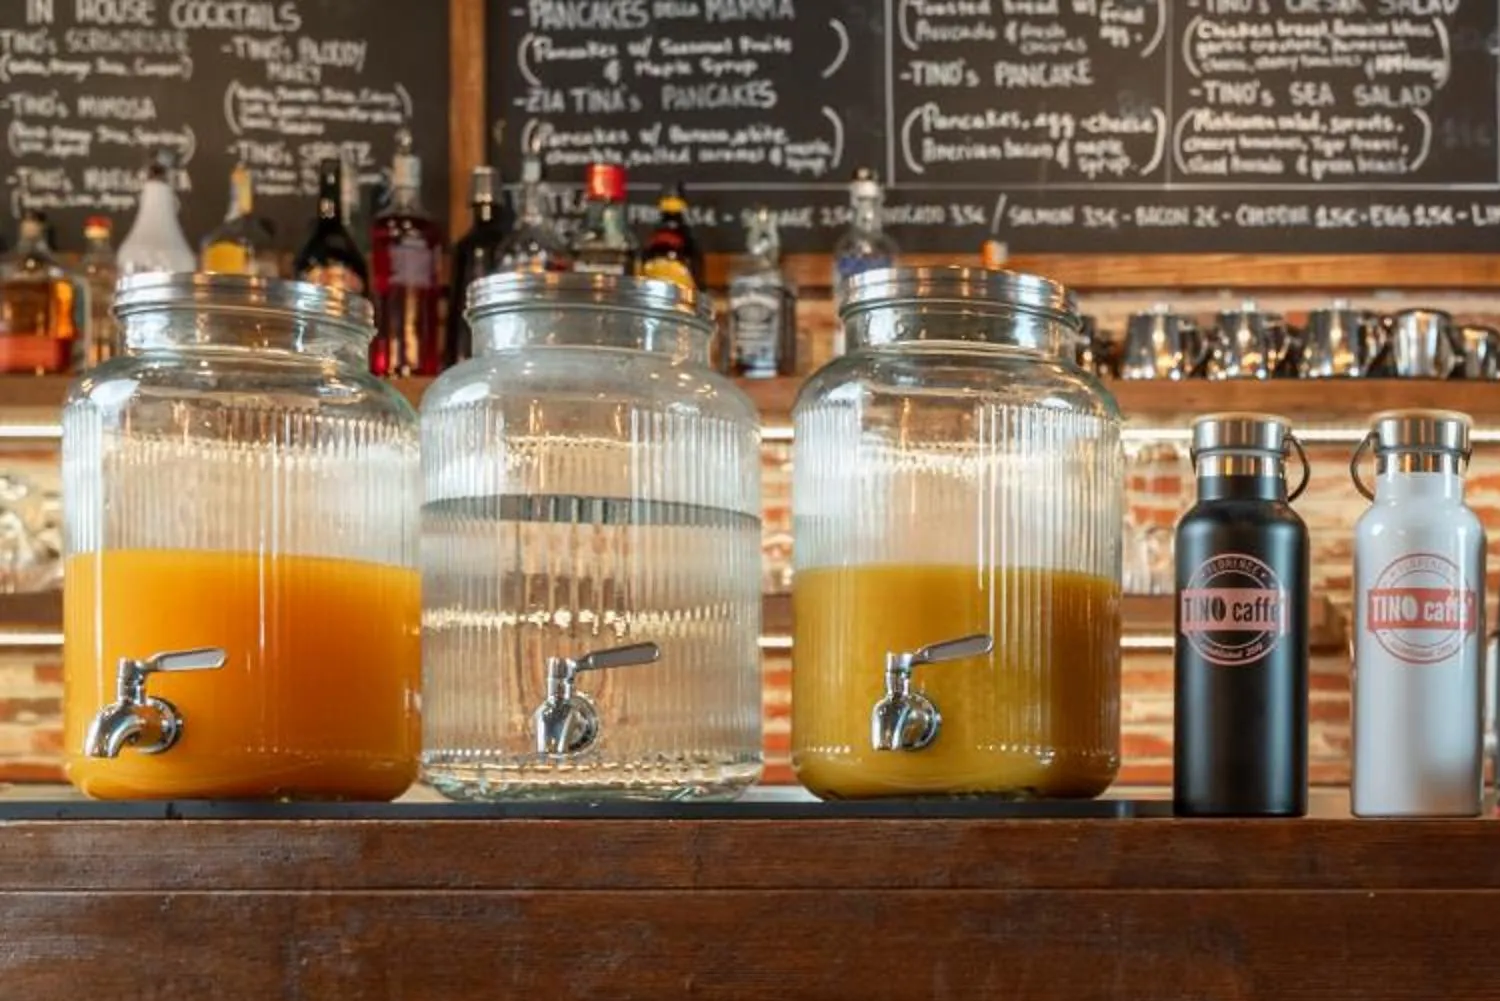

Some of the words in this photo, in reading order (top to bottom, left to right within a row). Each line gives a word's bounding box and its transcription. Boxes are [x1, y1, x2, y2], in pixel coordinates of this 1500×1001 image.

[26, 0, 54, 24] IN
[75, 0, 155, 26] HOUSE
[169, 0, 302, 32] COCKTAILS
[529, 0, 649, 30] PANCAKES
[993, 57, 1095, 89] PANCAKE
[661, 79, 779, 112] PANCAKES
[1288, 80, 1335, 107] SEA
[1351, 84, 1433, 109] SALAD
[1184, 596, 1227, 622] TINO
[1372, 595, 1418, 623] TINO
